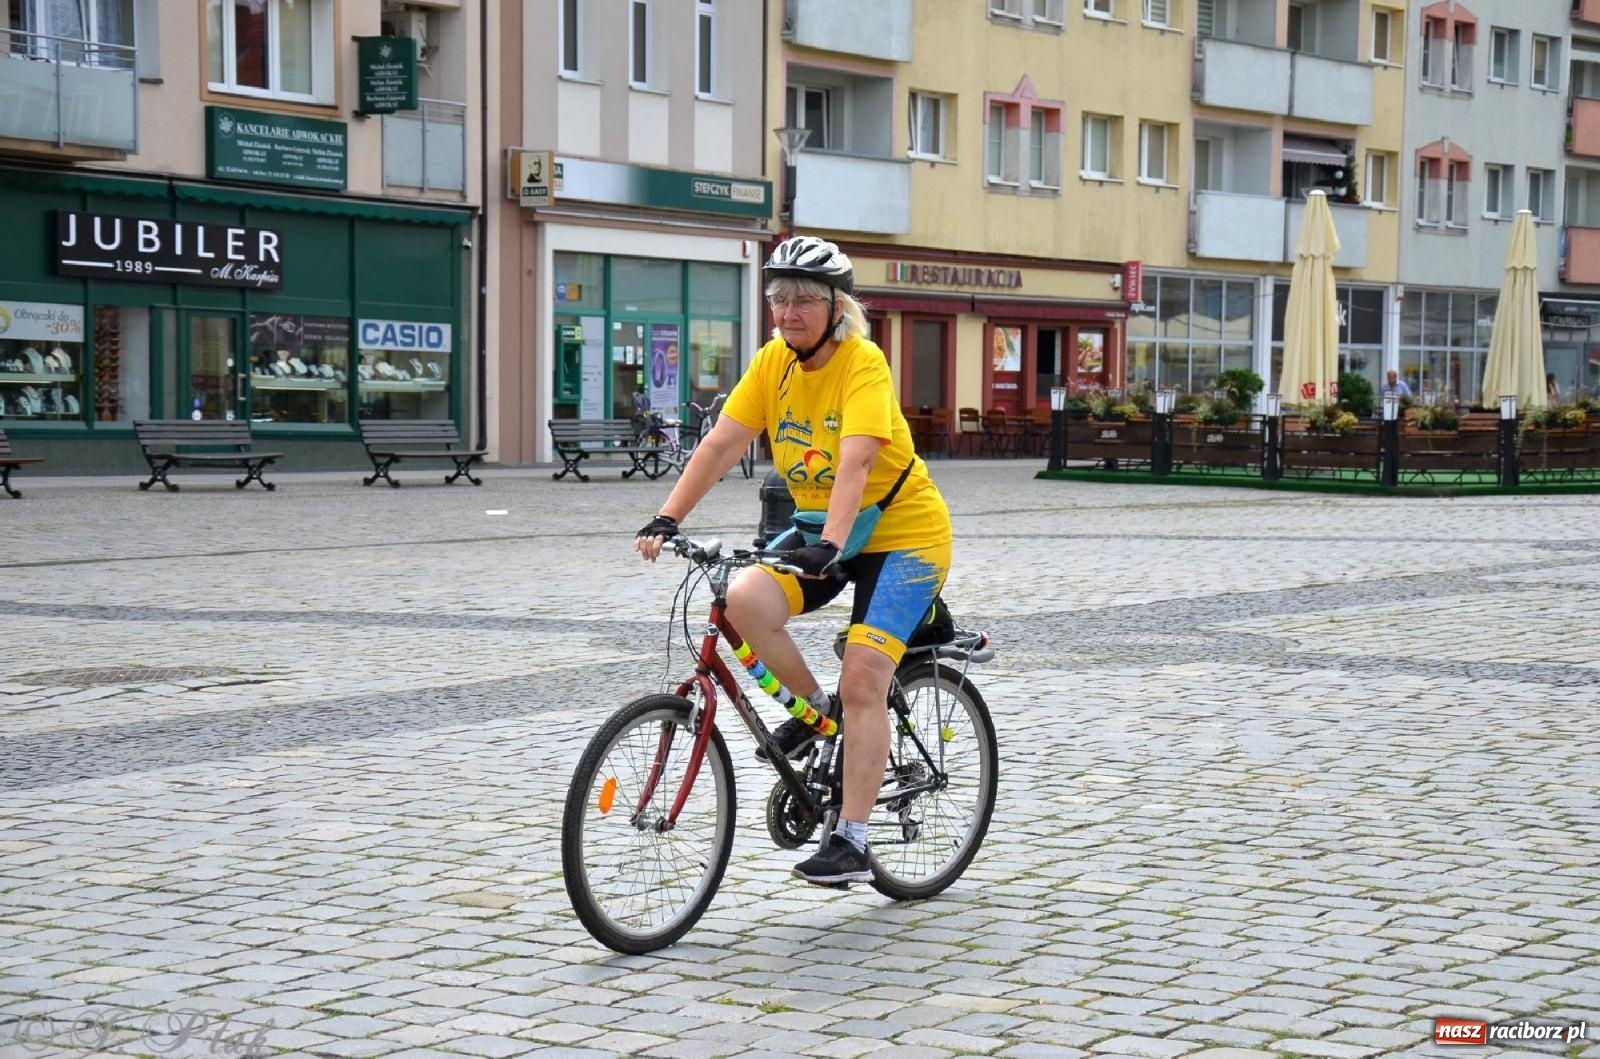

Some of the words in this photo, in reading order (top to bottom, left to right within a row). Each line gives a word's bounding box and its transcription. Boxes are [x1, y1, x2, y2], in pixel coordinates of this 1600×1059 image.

[236, 122, 290, 137] KANCELARIE
[292, 129, 343, 144] ADWOKACKIE
[694, 181, 730, 196] STEFCZYK
[61, 213, 280, 263] JUBILER
[115, 259, 153, 274] 1989
[210, 263, 232, 279] M.
[910, 264, 1023, 289] RESTAURACJA
[58, 310, 70, 322] do
[45, 319, 81, 336] -30%
[361, 322, 443, 349] CASIO
